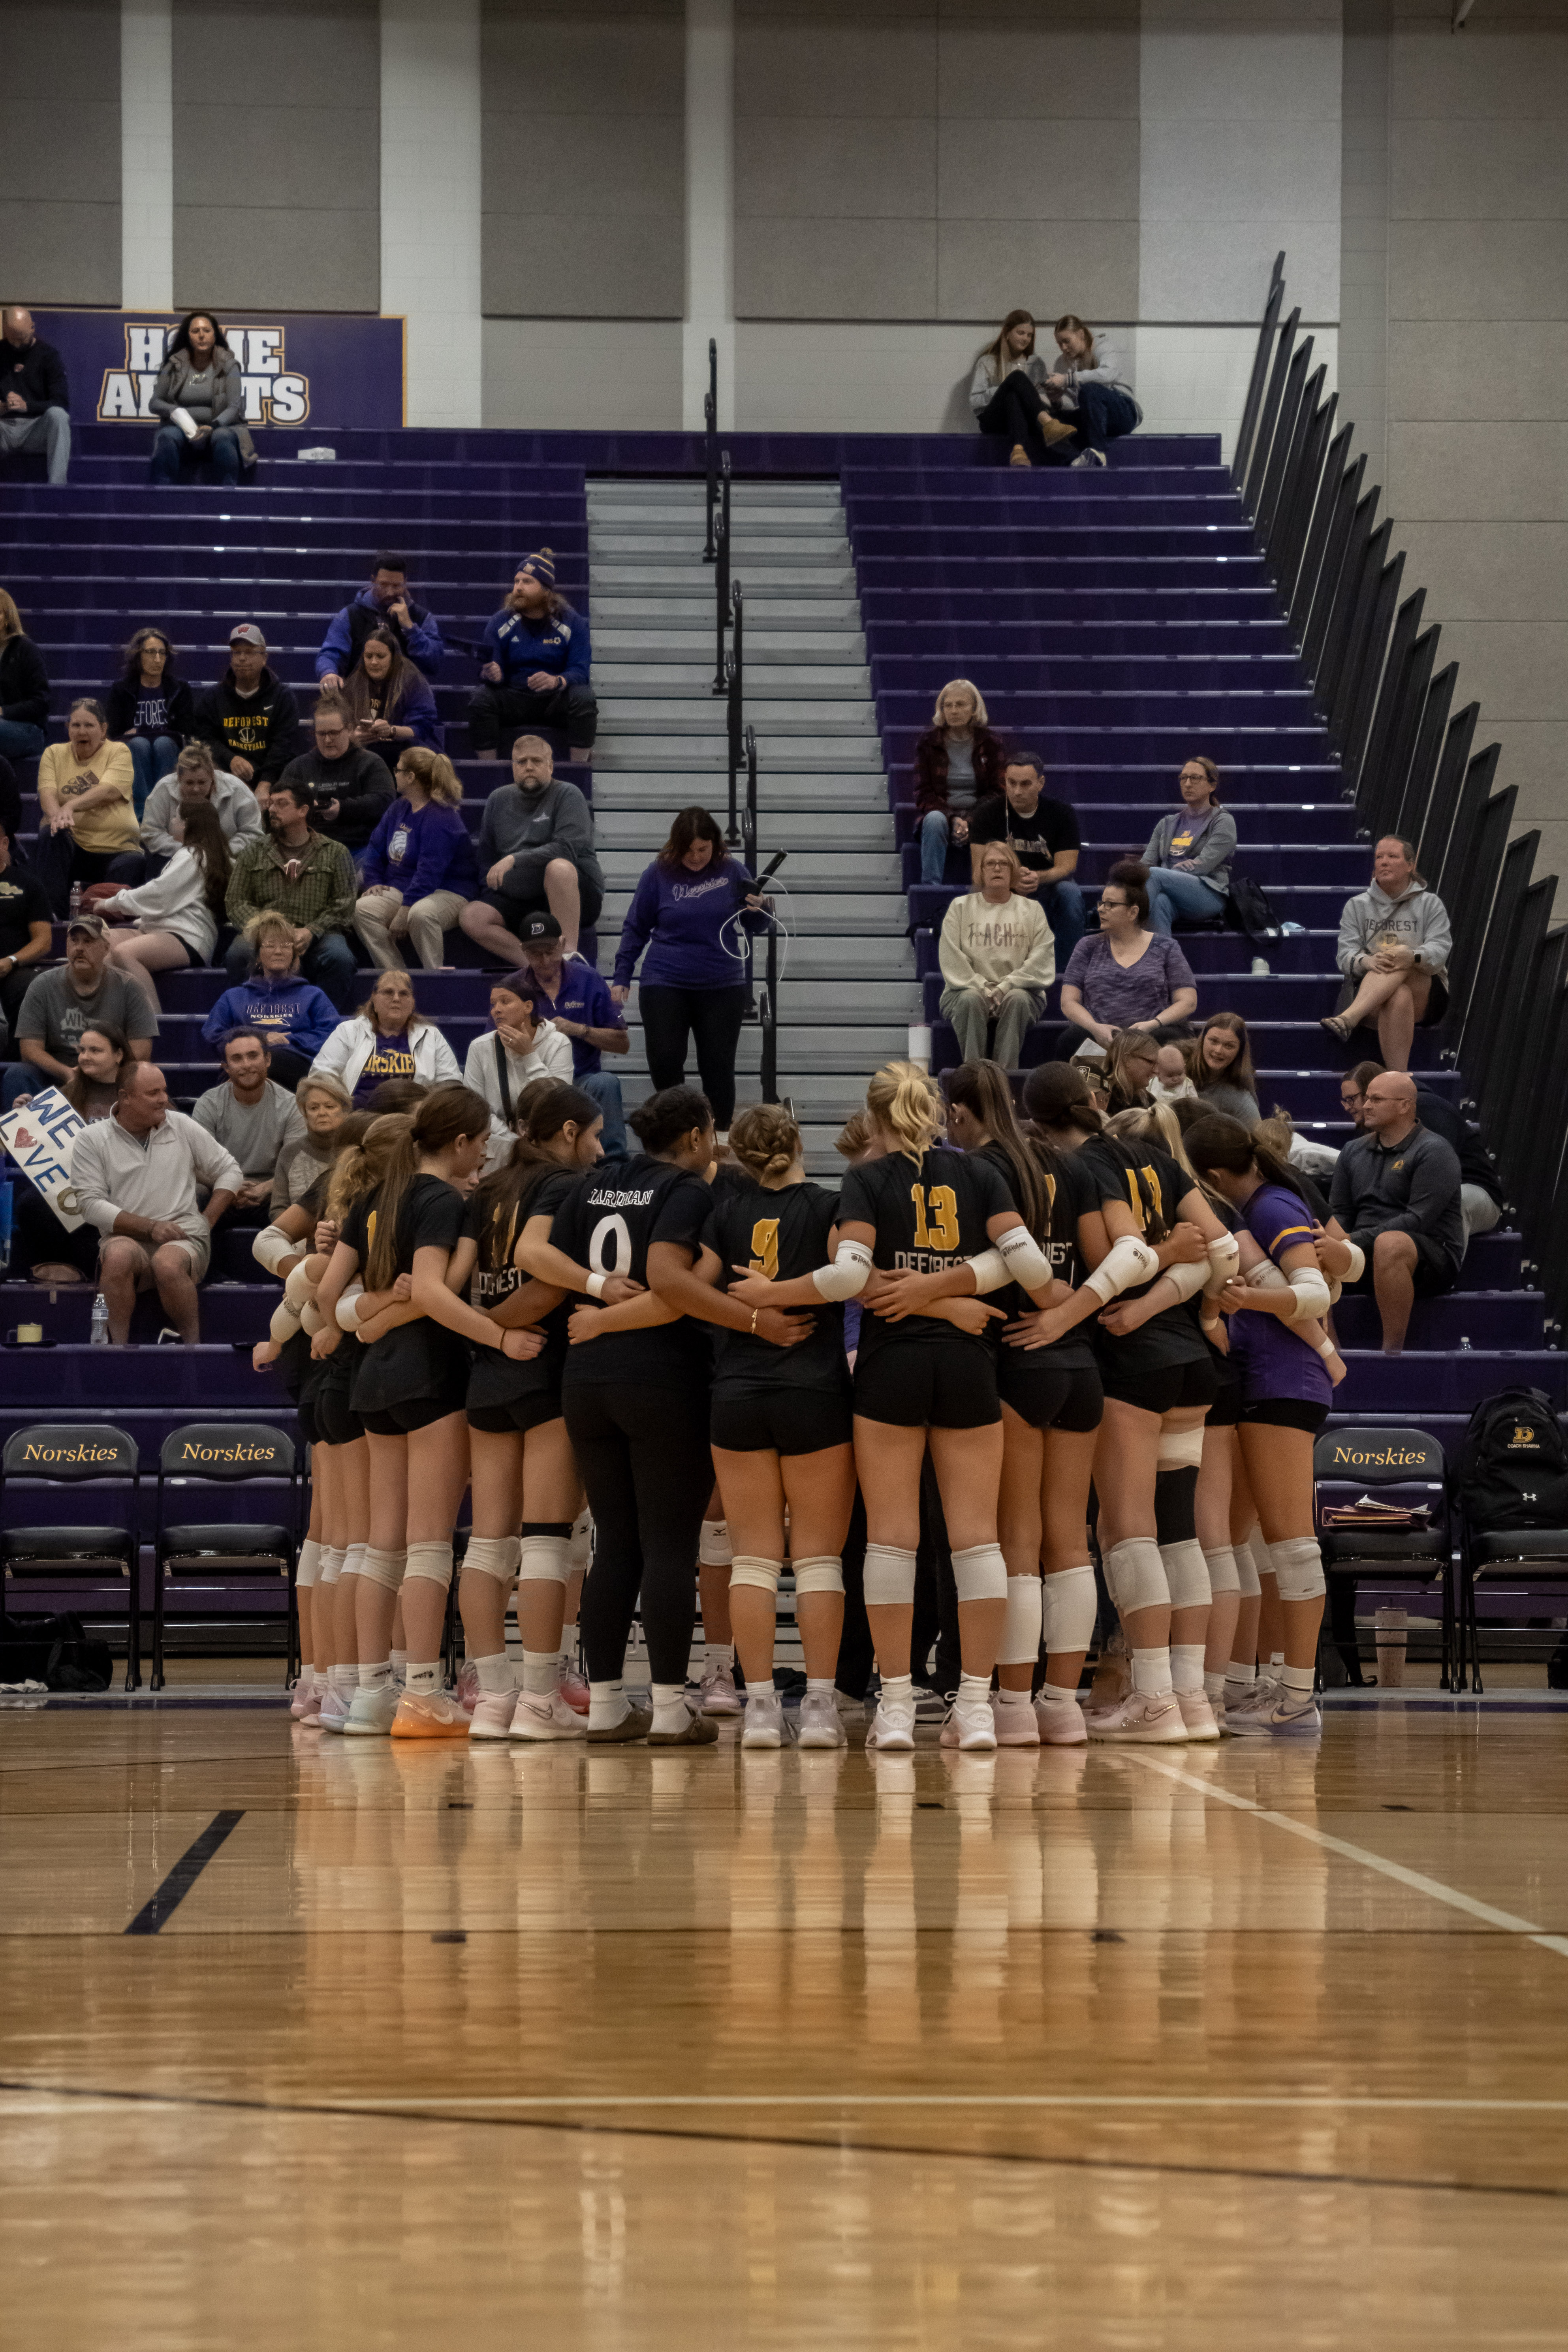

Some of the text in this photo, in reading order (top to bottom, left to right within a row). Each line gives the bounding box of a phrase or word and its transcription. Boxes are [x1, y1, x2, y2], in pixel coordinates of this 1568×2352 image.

[130, 328, 280, 373] HME
[102, 373, 306, 421] ATS
[223, 716, 269, 727] DEFOREST
[228, 738, 266, 751] BASKETBALL
[532, 923, 544, 935] D
[1365, 919, 1418, 933] DEFOREST
[26, 1089, 85, 1150] WE
[0, 1112, 70, 1193] LVE
[911, 1183, 960, 1251] 13
[588, 1213, 632, 1278] 0
[749, 1218, 780, 1281] 9
[895, 1251, 972, 1273] DEFOR
[23, 1444, 118, 1462] Norskies
[181, 1443, 275, 1461] Norskies
[1333, 1447, 1426, 1465] Norskies
